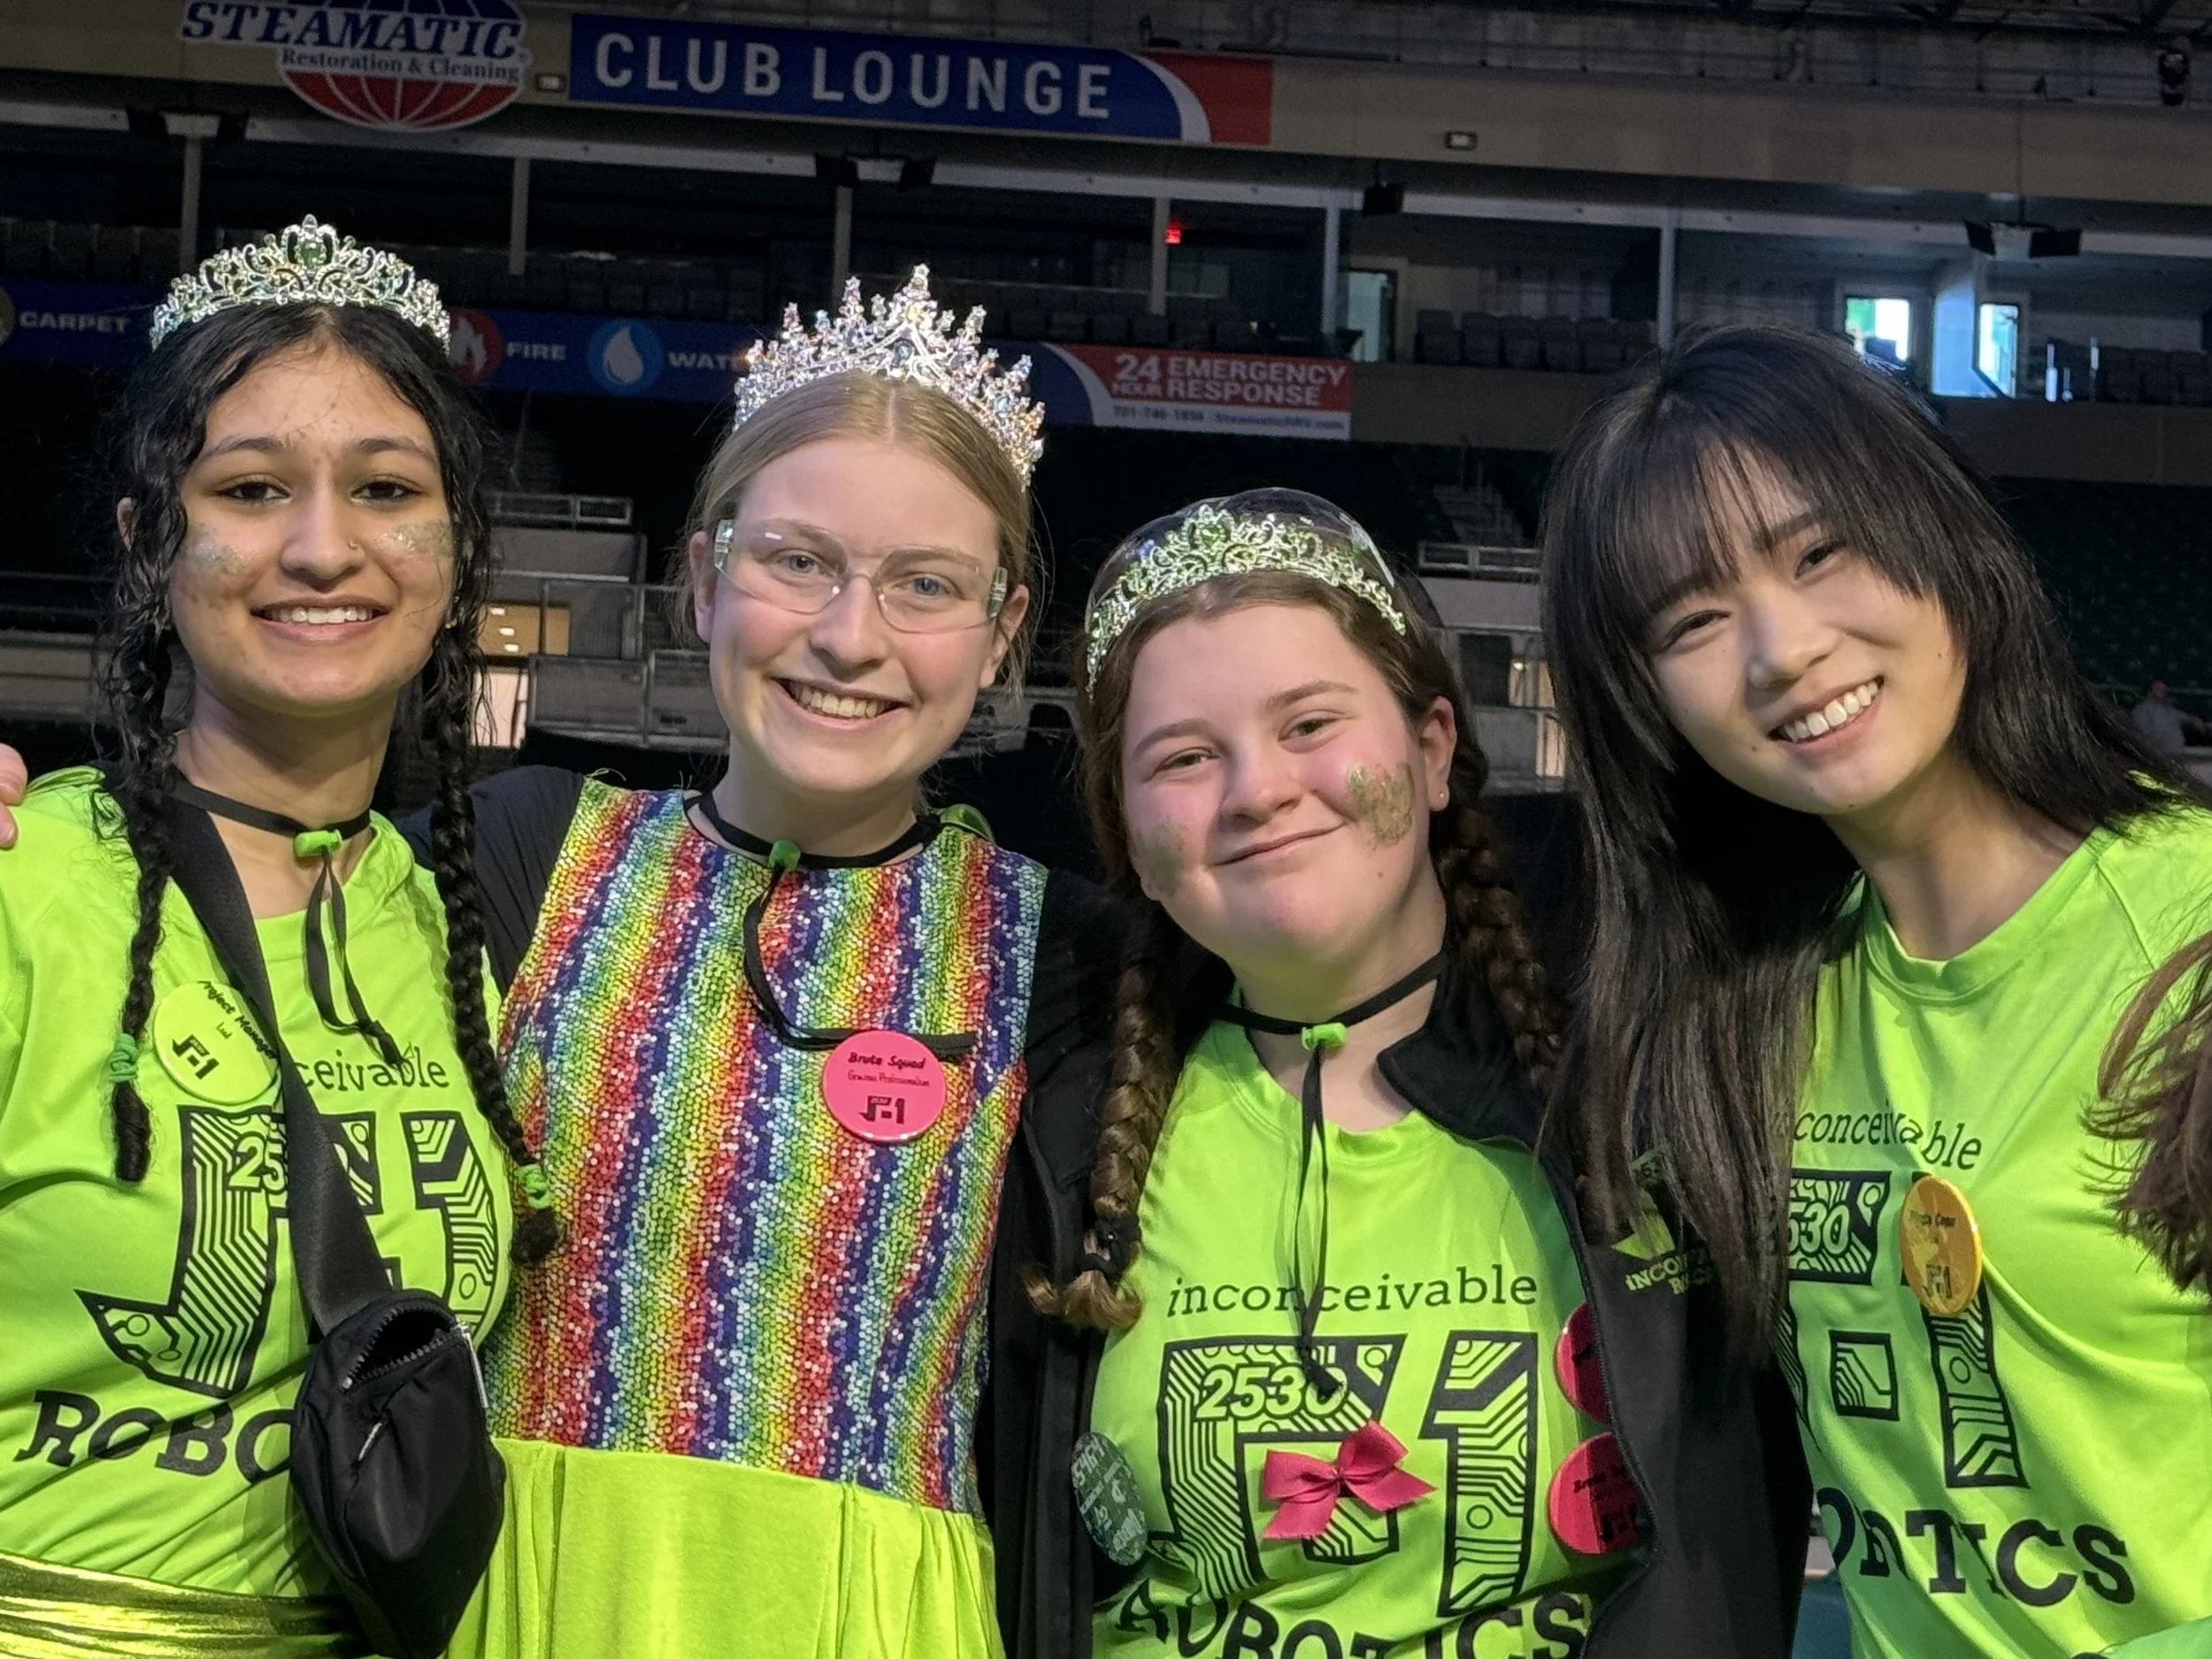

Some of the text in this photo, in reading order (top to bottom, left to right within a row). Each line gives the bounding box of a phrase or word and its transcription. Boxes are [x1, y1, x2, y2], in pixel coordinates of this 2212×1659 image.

[182, 2, 522, 59] STEAMATIC
[282, 49, 521, 82] Restoration & Cleaning
[594, 32, 1112, 119] CLUB LOUNGE
[19, 310, 130, 334] CARPET
[506, 341, 567, 361] FIRE
[1115, 352, 1347, 386] 24 EMERGENCY
[1168, 378, 1321, 407] RESPONSE
[848, 1051, 926, 1071] Brute Squad
[1166, 1263, 1538, 1317] inconceivable
[1194, 1362, 1348, 1423] 2530
